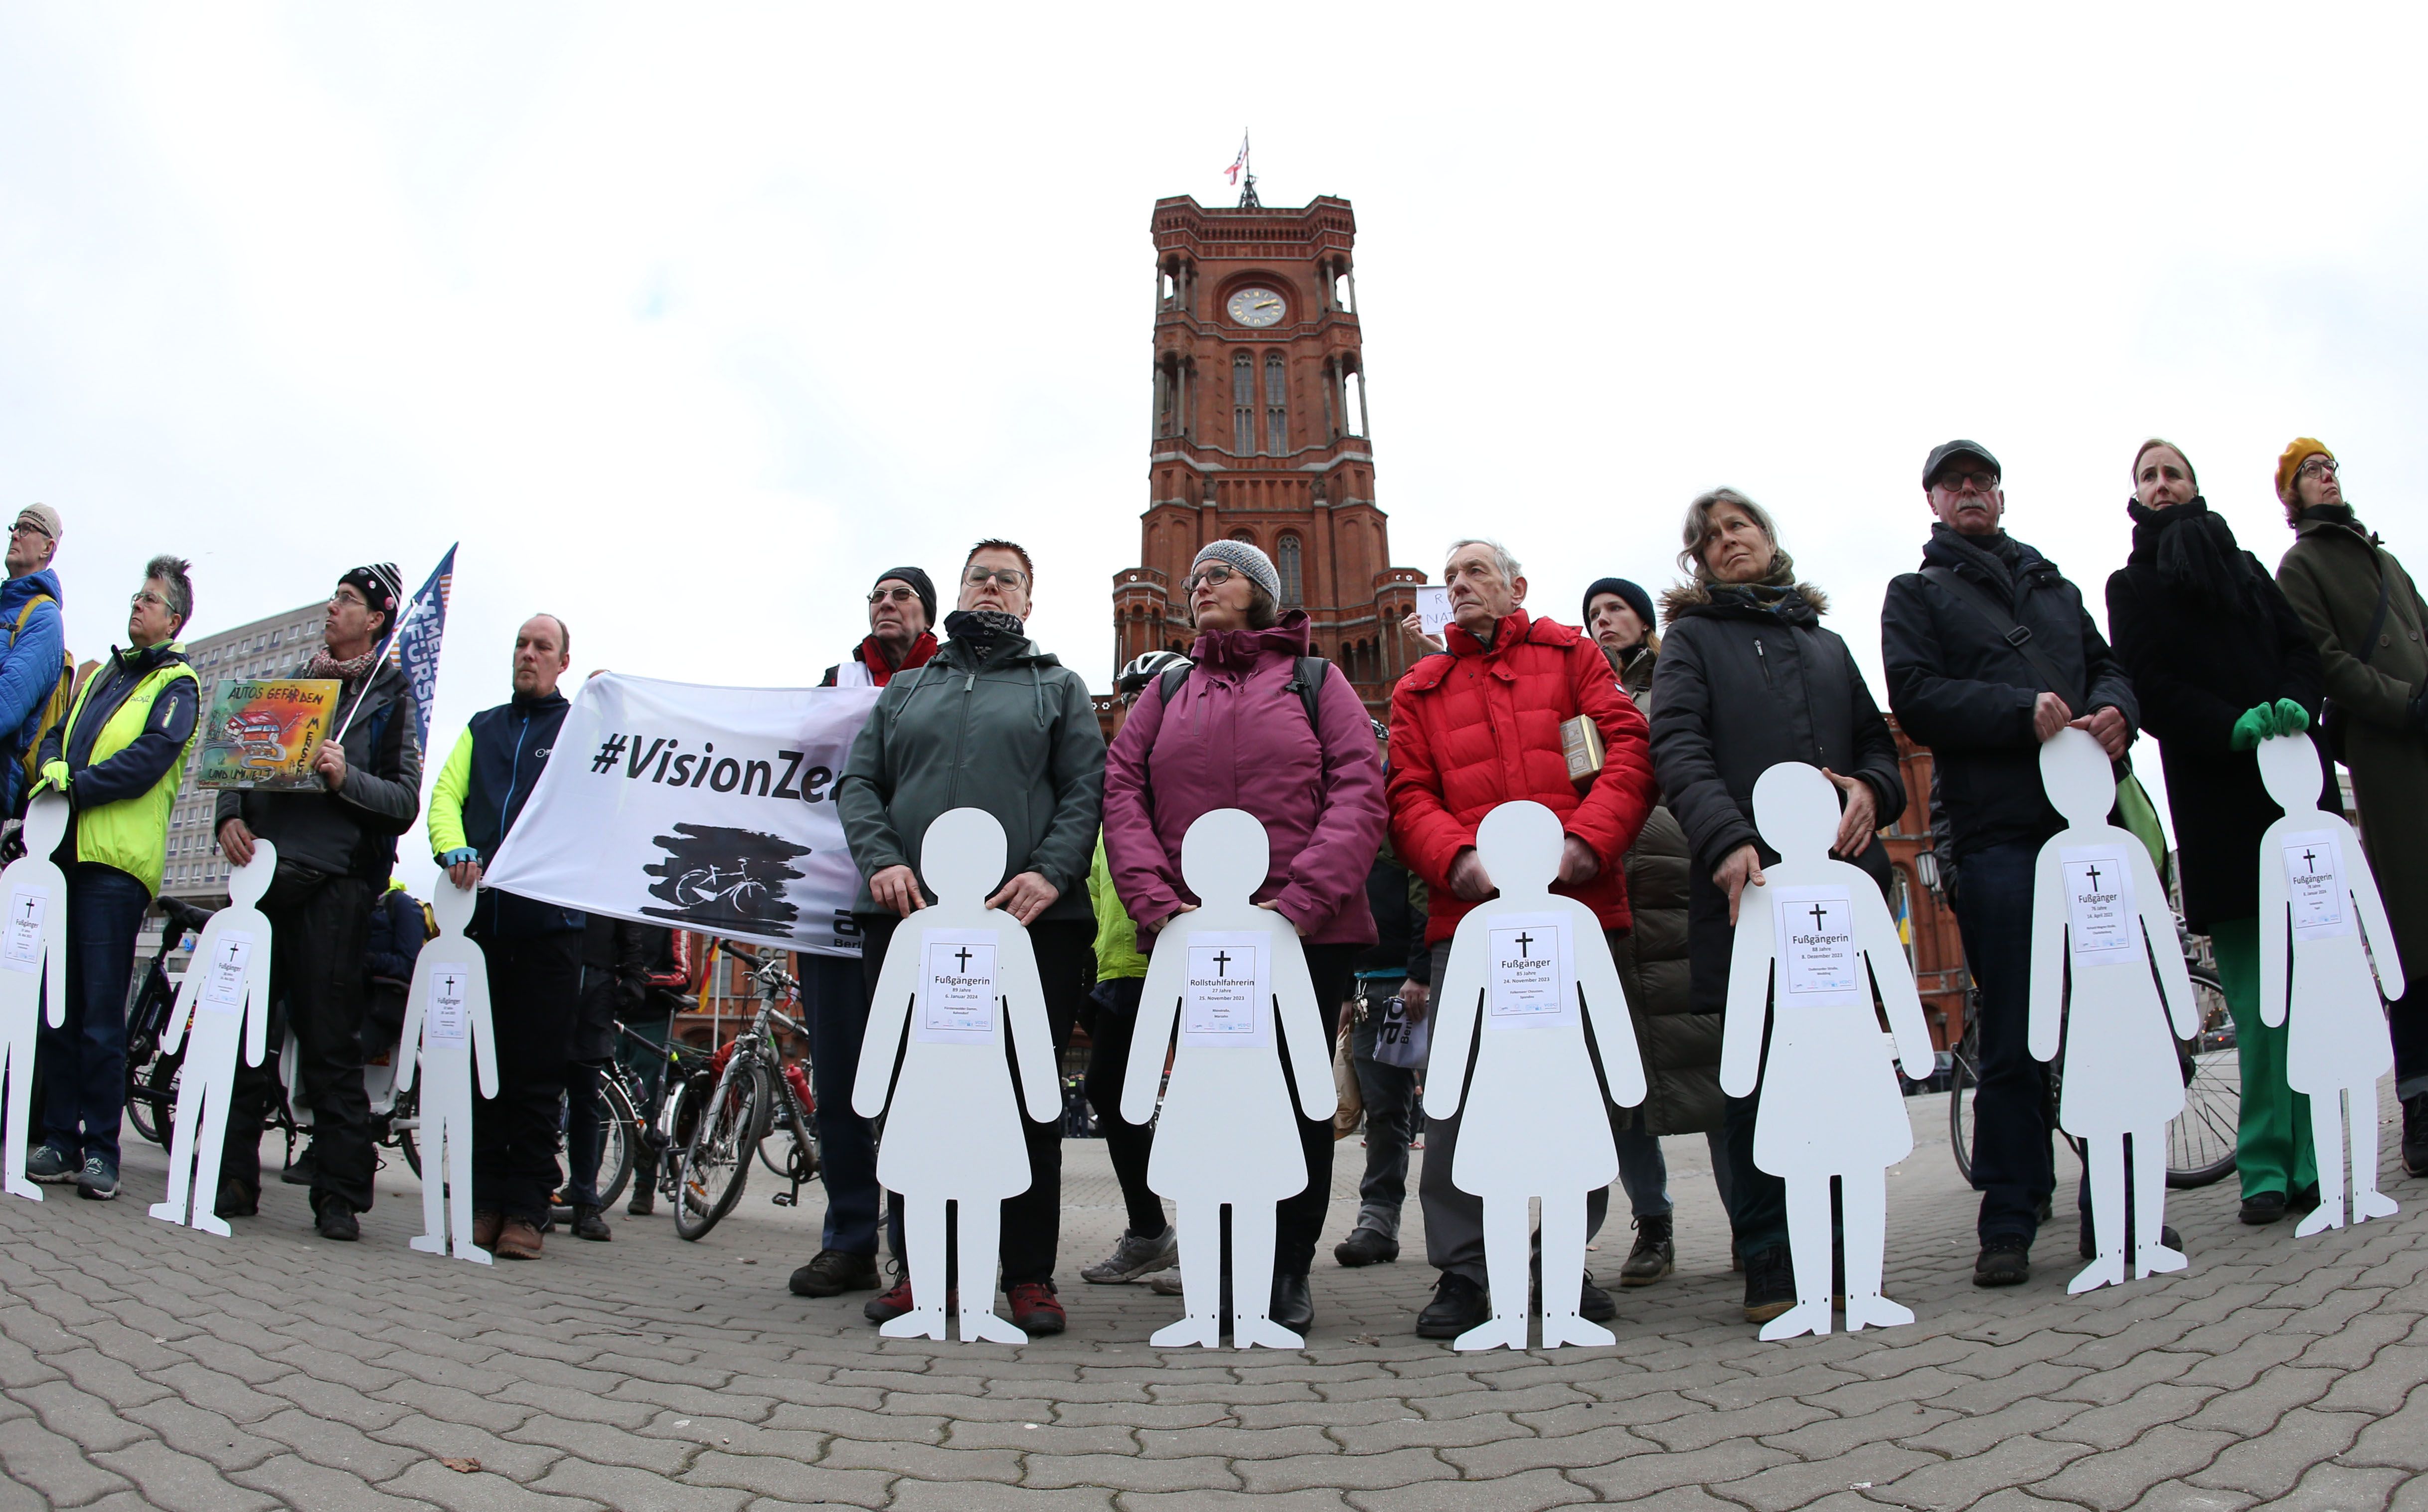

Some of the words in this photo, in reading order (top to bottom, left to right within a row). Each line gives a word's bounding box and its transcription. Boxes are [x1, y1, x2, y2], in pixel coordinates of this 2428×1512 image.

[227, 686, 263, 700] AUTOS
[208, 768, 228, 779] UND
[591, 733, 841, 804] #VisionZe
[2293, 873, 2332, 885] Fußgängerin
[2078, 894, 2117, 904] Fußgänger
[834, 938, 861, 948] Berl
[1792, 933, 1849, 945] Fußgängerin
[1501, 959, 1551, 969] Fußgänger
[935, 976, 990, 986] Fußgängerin
